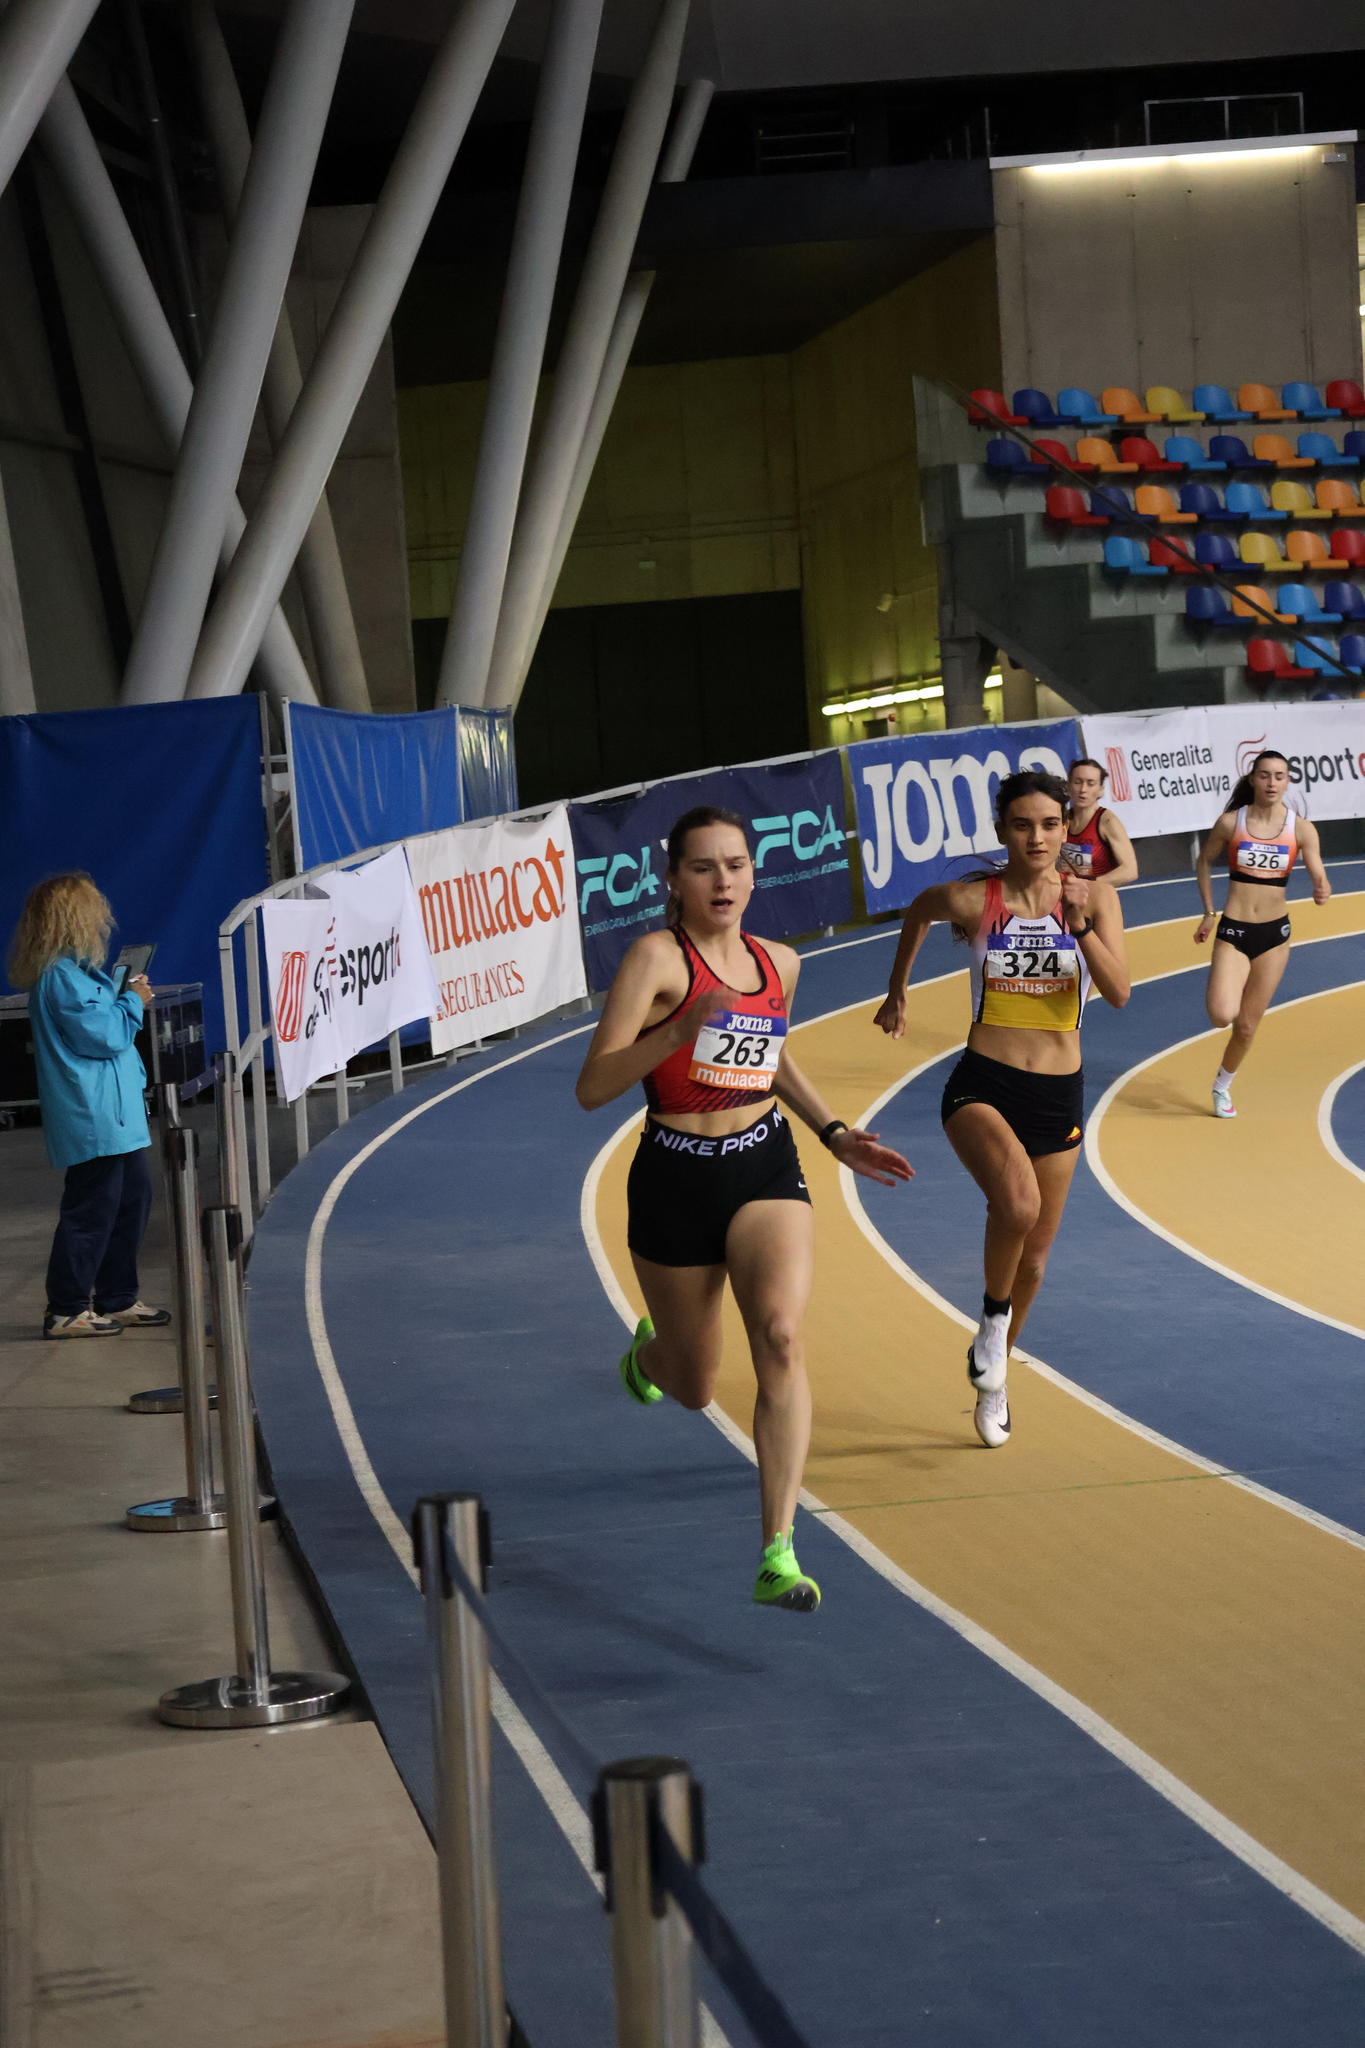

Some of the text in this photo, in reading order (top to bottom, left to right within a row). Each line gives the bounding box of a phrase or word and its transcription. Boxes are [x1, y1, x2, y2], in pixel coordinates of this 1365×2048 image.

[1137, 778, 1156, 800] de
[751, 805, 846, 868] FCA
[1245, 852, 1280, 869] 326
[577, 846, 660, 915] FCA
[419, 838, 566, 955] mutuacat
[1002, 951, 1061, 978] 324
[726, 1014, 773, 1033] Joma
[712, 1033, 769, 1067] 263
[696, 1067, 774, 1089] mutuacat
[654, 1123, 769, 1157] NIKE PRO
